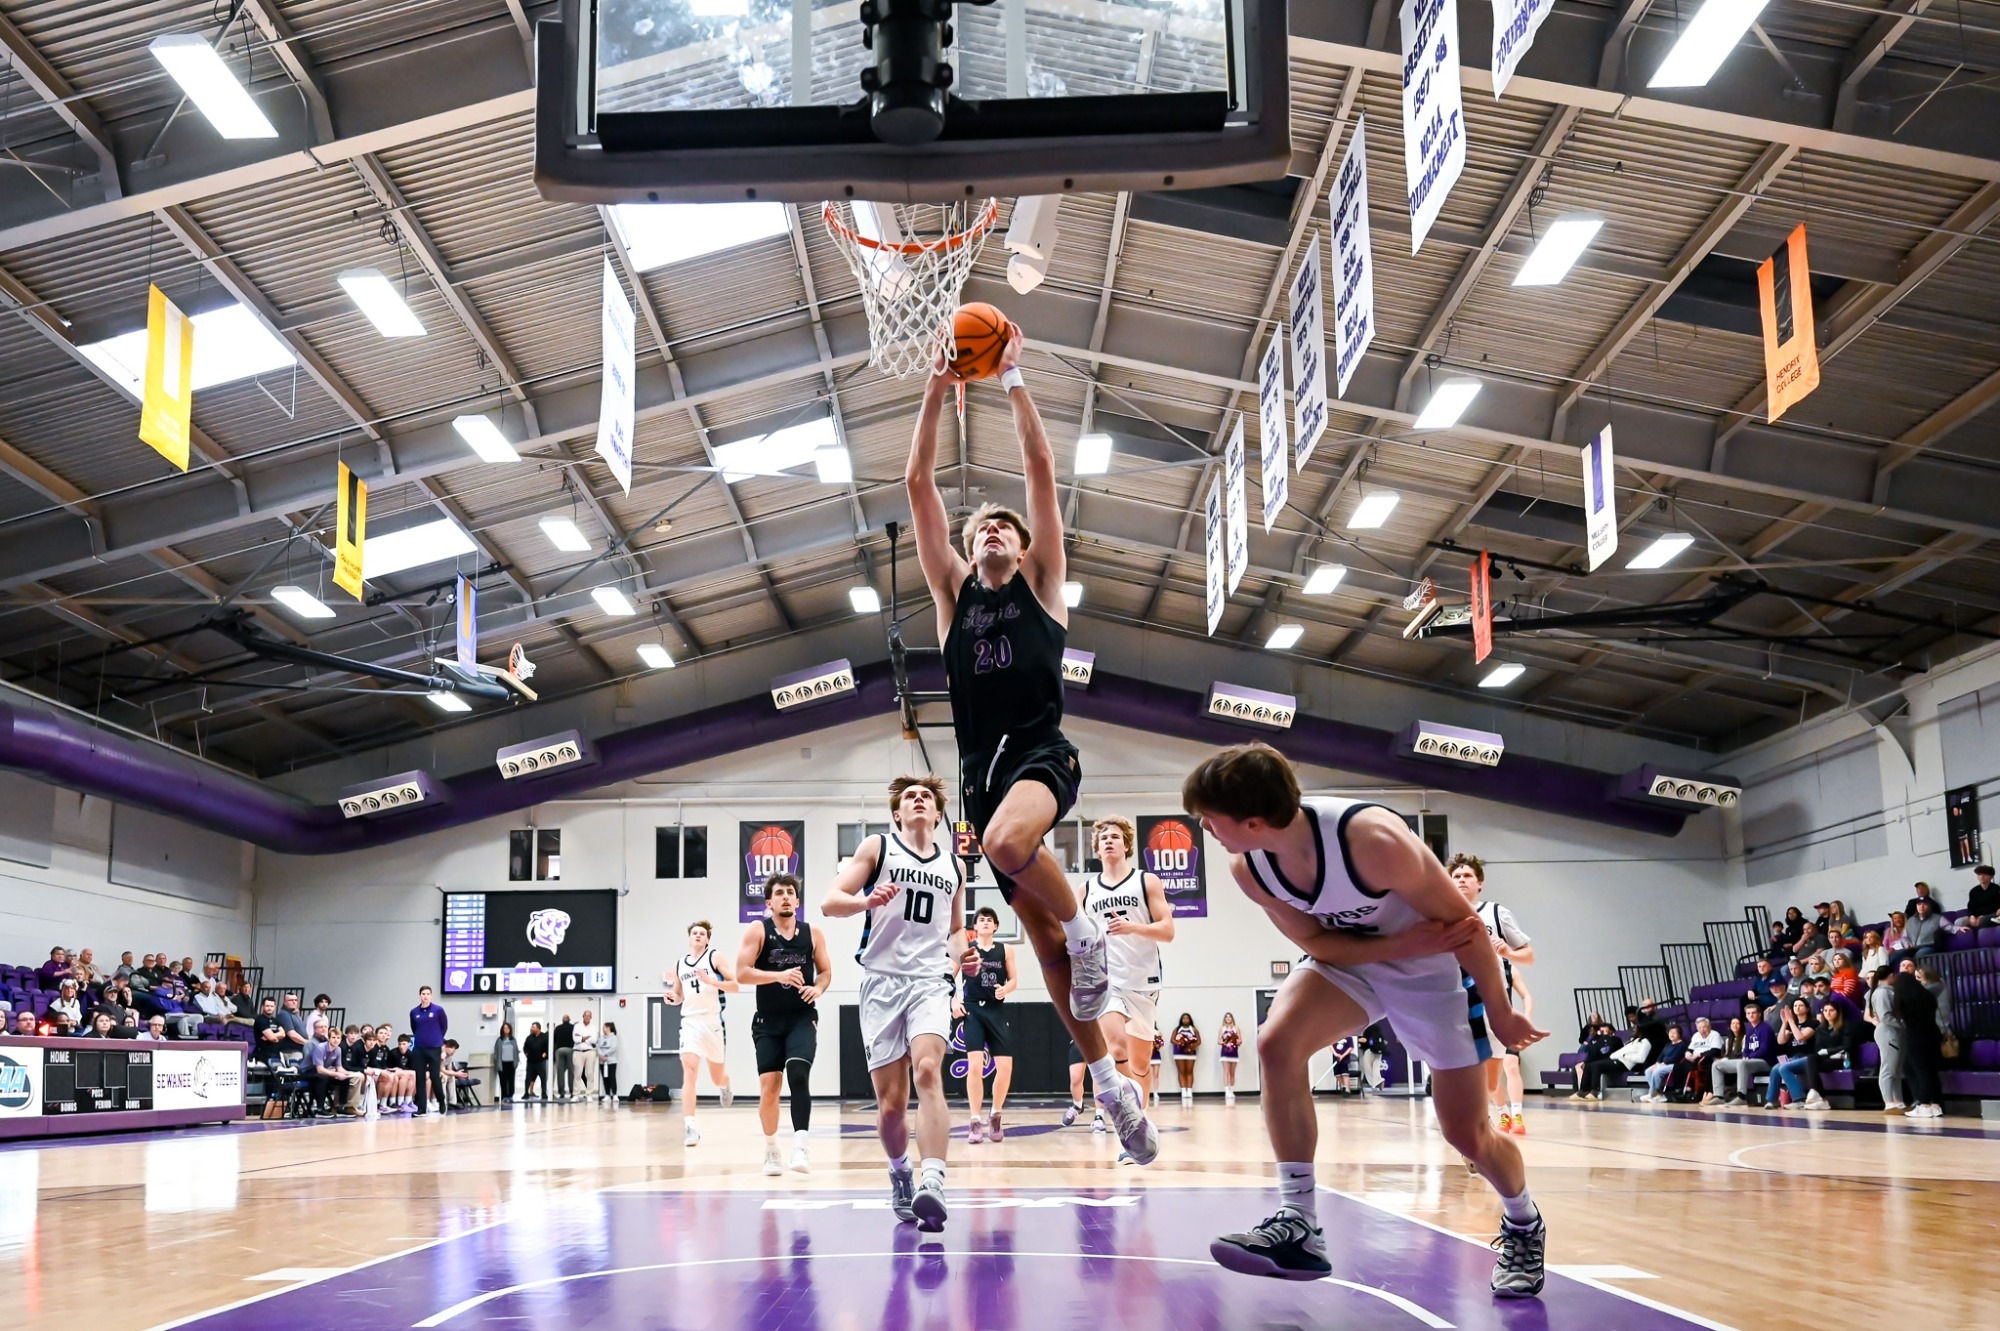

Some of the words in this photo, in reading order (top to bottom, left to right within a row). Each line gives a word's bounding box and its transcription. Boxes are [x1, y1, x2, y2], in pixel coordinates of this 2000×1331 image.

[1420, 103, 1443, 164] NCAA
[1409, 109, 1459, 216] OURNAMENT
[1776, 354, 1800, 381] HENDRIX
[1776, 366, 1802, 394] COLLEGE
[974, 635, 1012, 674] 20
[755, 854, 788, 876] 100
[1153, 848, 1188, 871] 100
[889, 868, 953, 895] VIKINGS
[1161, 878, 1196, 889] WANEE
[904, 888, 934, 924] 10
[1092, 896, 1138, 913] VIKINGS
[479, 975, 491, 990] 0
[565, 974, 576, 990] 0
[691, 979, 700, 993] 4
[981, 972, 997, 987] 22
[50, 1051, 70, 1063] HOME
[128, 1052, 150, 1063] VISITOR
[156, 1073, 192, 1089] SEWANEE
[214, 1071, 238, 1086] TIGERS
[60, 1102, 77, 1112] BONUS
[95, 1100, 111, 1109] PERIOD
